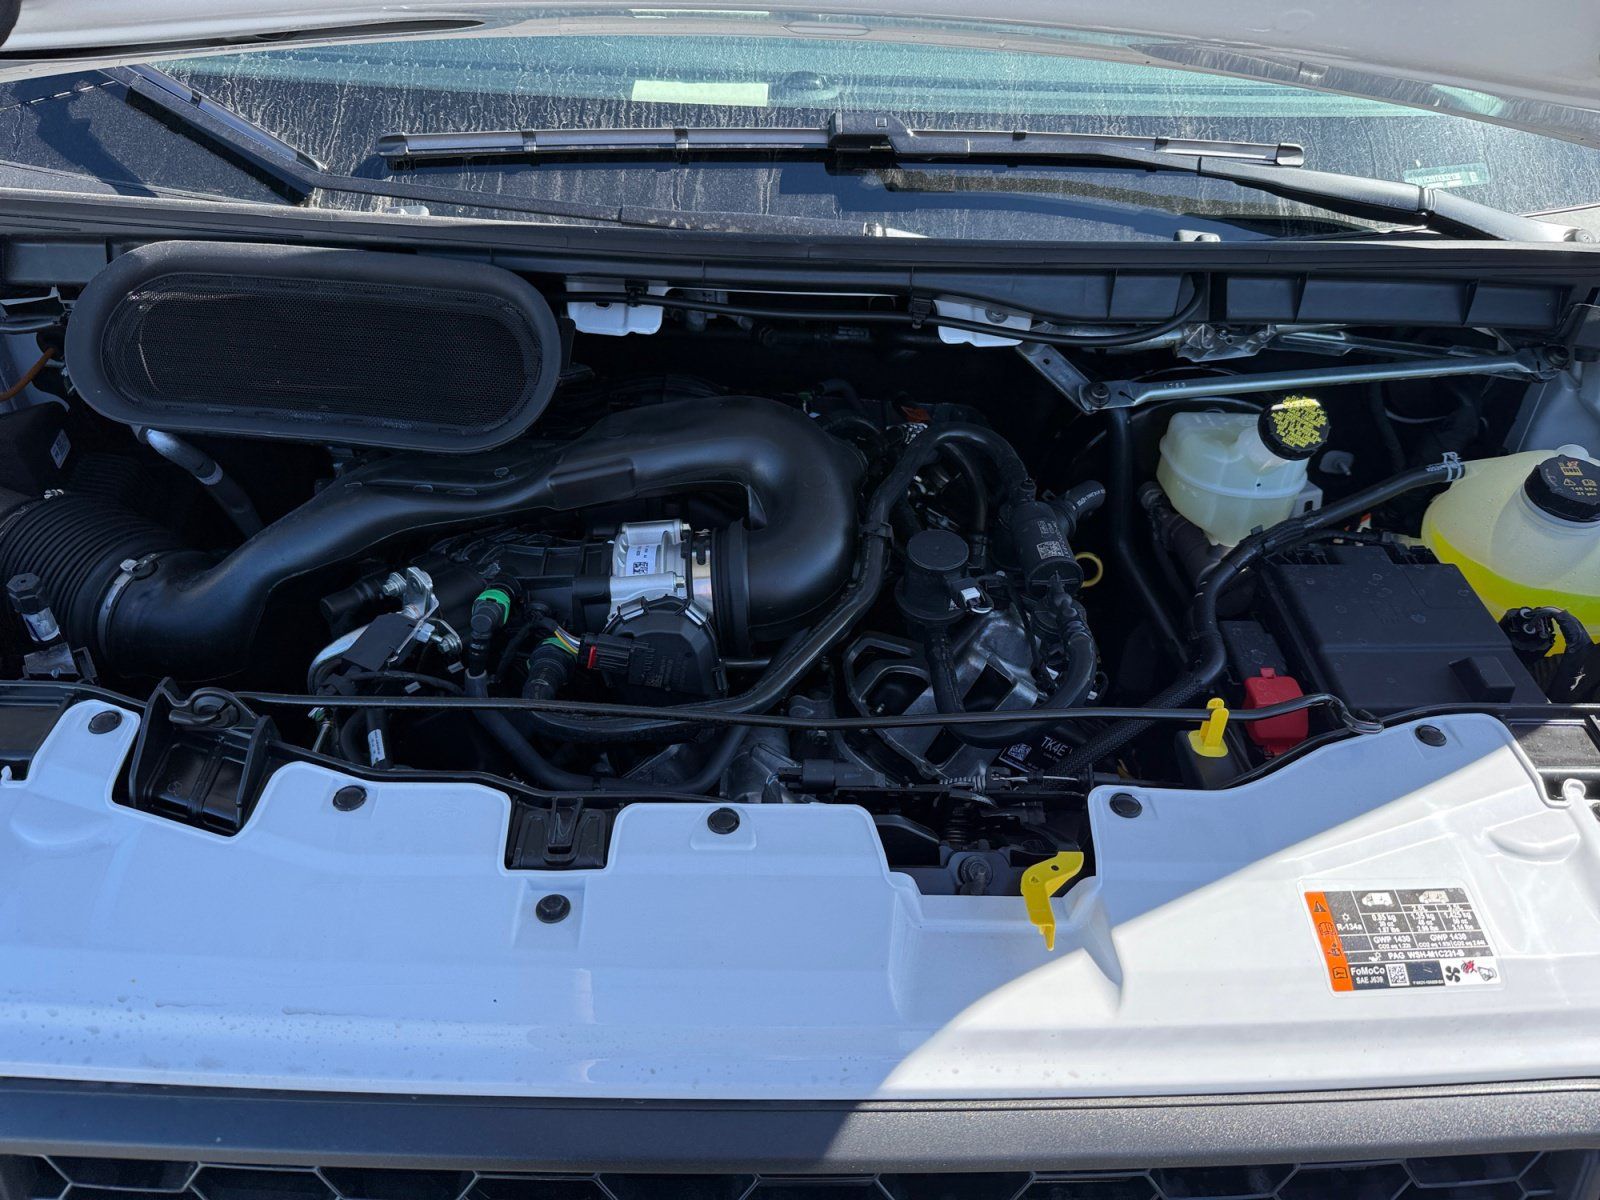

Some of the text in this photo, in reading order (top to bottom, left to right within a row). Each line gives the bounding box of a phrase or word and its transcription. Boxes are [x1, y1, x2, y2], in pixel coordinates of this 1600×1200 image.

[1336, 923, 1363, 931] R-134a
[1373, 935, 1411, 944] GWP 1430
[1430, 933, 1448, 941] GWP
[1387, 952, 1405, 960] PAG
[1350, 966, 1385, 976] FoMoCo
[1356, 976, 1369, 984] SAE
